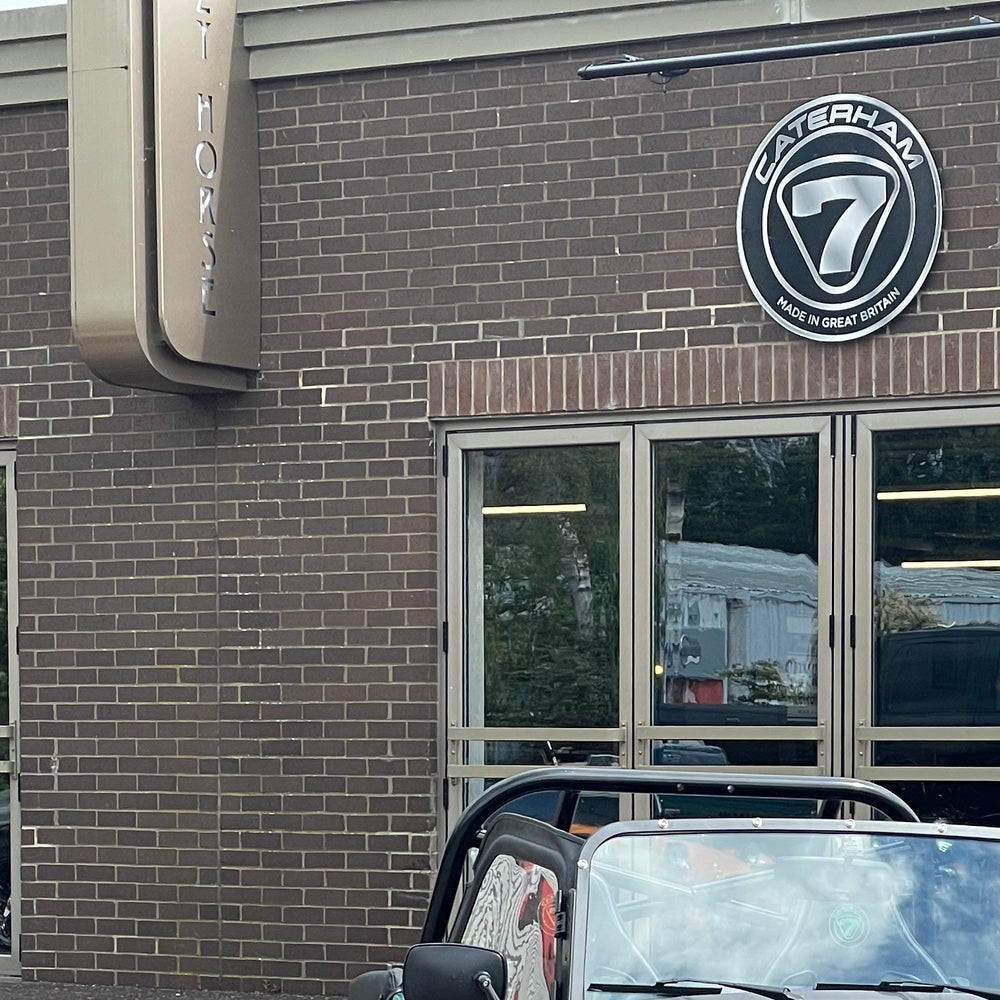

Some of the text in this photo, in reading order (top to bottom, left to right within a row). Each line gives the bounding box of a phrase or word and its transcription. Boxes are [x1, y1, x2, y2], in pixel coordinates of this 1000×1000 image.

[755, 104, 924, 185] CATERHAM
[195, 93, 217, 317] HORSE
[792, 175, 887, 275] 7
[777, 286, 902, 329] MADE IN GREAT BRITAIN
